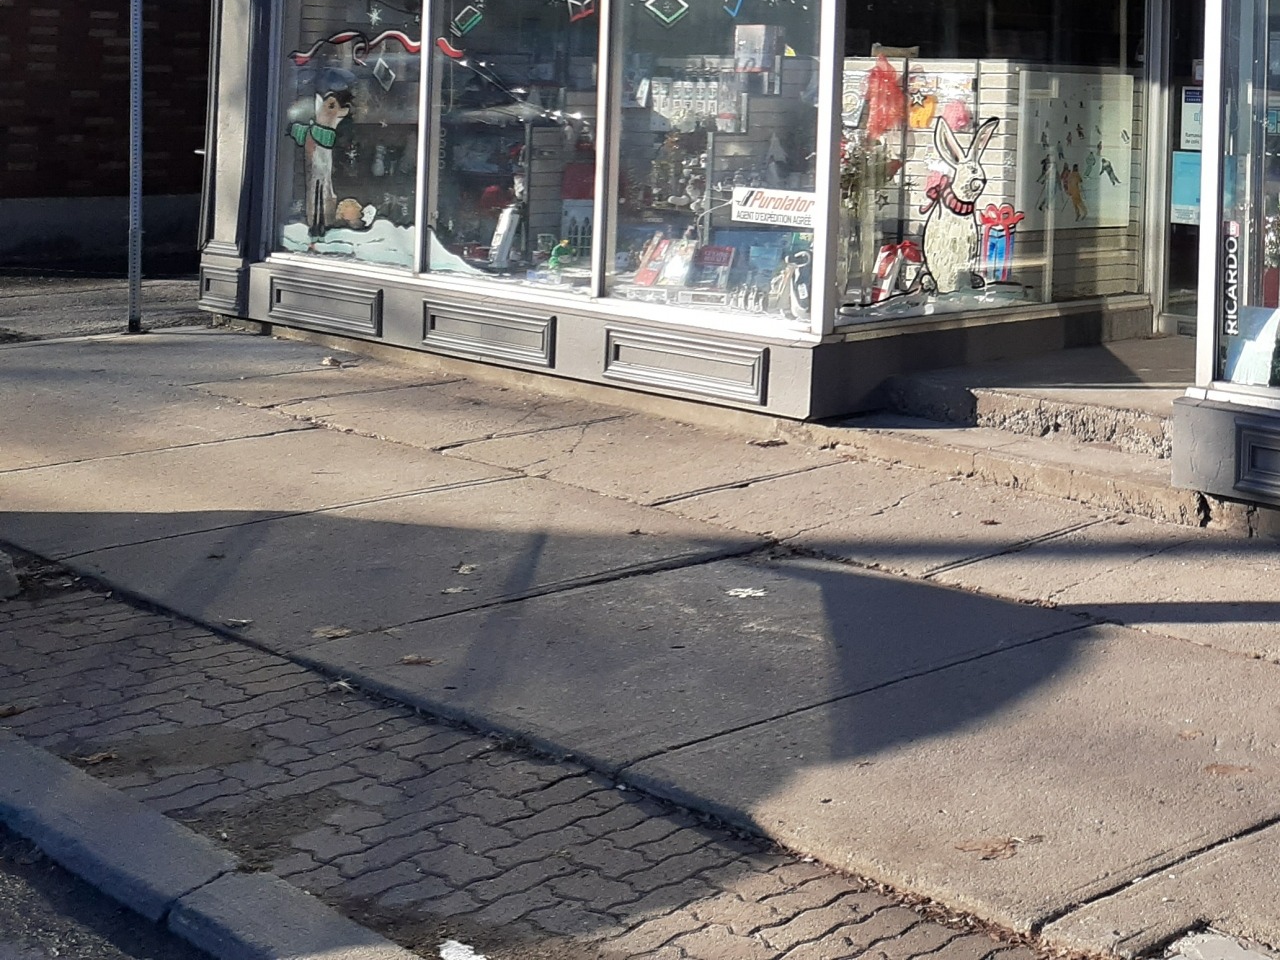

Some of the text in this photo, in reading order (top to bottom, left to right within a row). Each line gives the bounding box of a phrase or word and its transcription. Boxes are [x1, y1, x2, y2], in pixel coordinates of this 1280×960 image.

[749, 190, 816, 213] Purolator
[736, 210, 755, 221] AGENT
[1224, 236, 1239, 335] RICARDO
